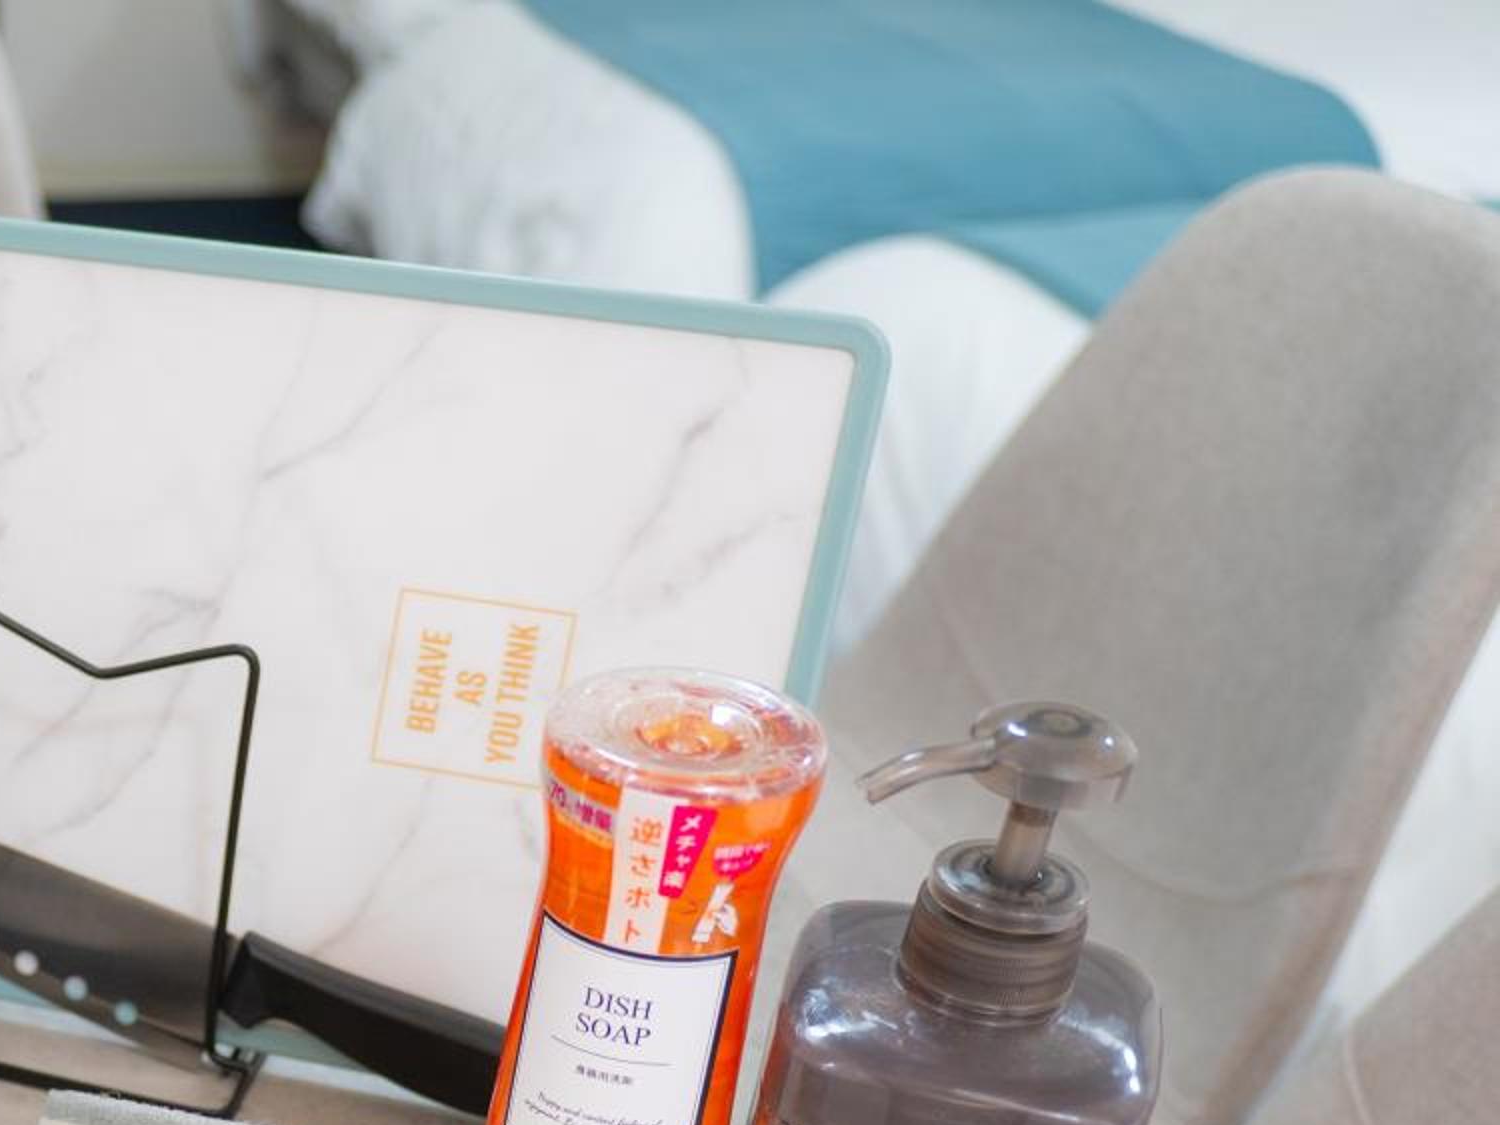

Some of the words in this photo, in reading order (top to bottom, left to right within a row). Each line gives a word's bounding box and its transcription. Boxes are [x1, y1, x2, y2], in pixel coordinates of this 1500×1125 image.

[405, 629, 452, 733] BEHAVE
[496, 624, 540, 703] THINK
[454, 671, 487, 705] AS
[485, 710, 523, 764] YOU
[585, 987, 651, 1019] DISH
[576, 1012, 651, 1045] SOAP
